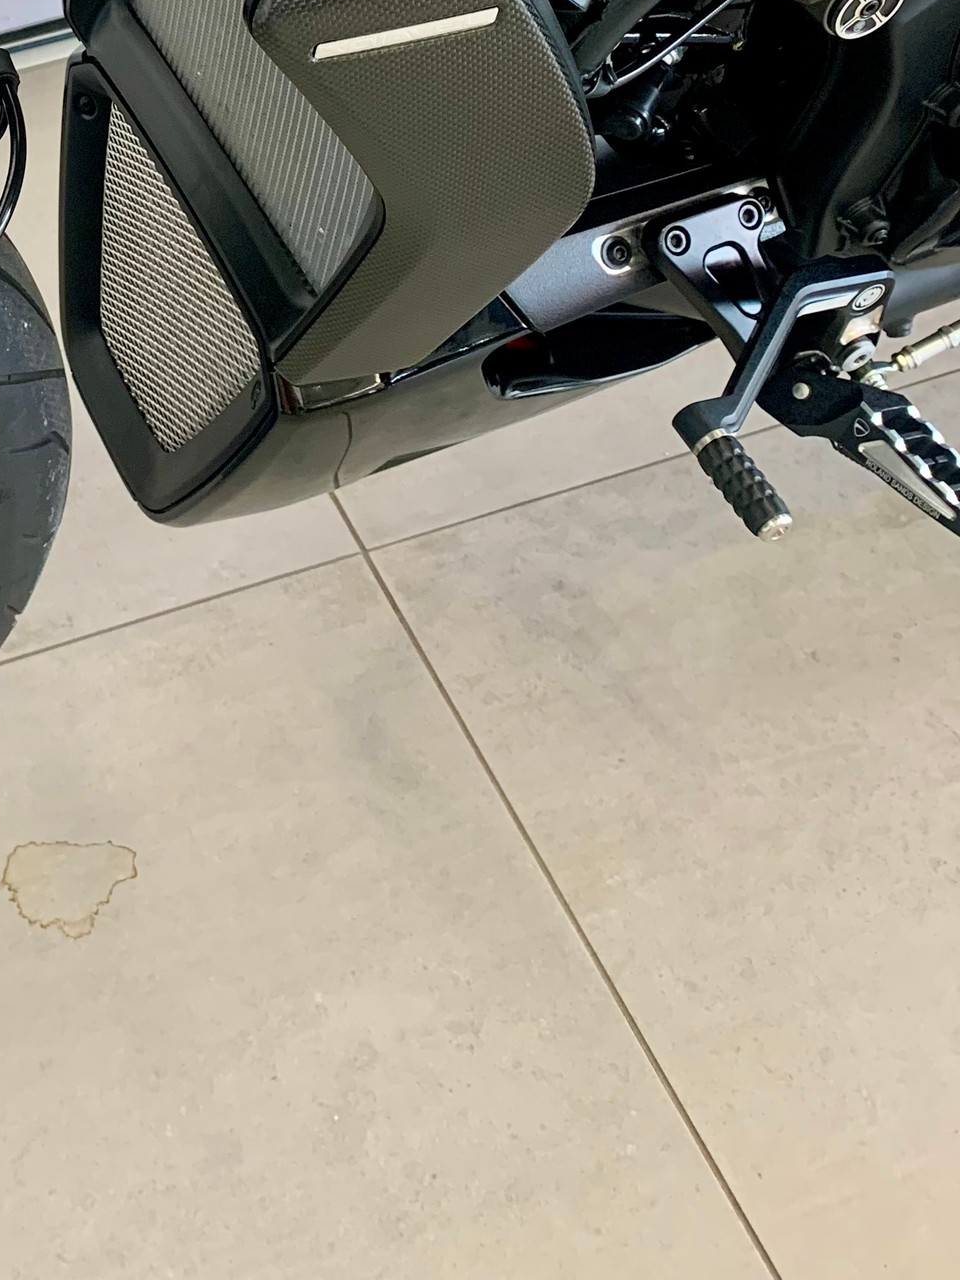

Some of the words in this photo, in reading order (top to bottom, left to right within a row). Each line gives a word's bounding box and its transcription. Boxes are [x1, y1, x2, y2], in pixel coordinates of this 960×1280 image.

[866, 460, 892, 483] ROLAND
[890, 478, 914, 500] SANDS
[913, 496, 940, 520] DESIGN
